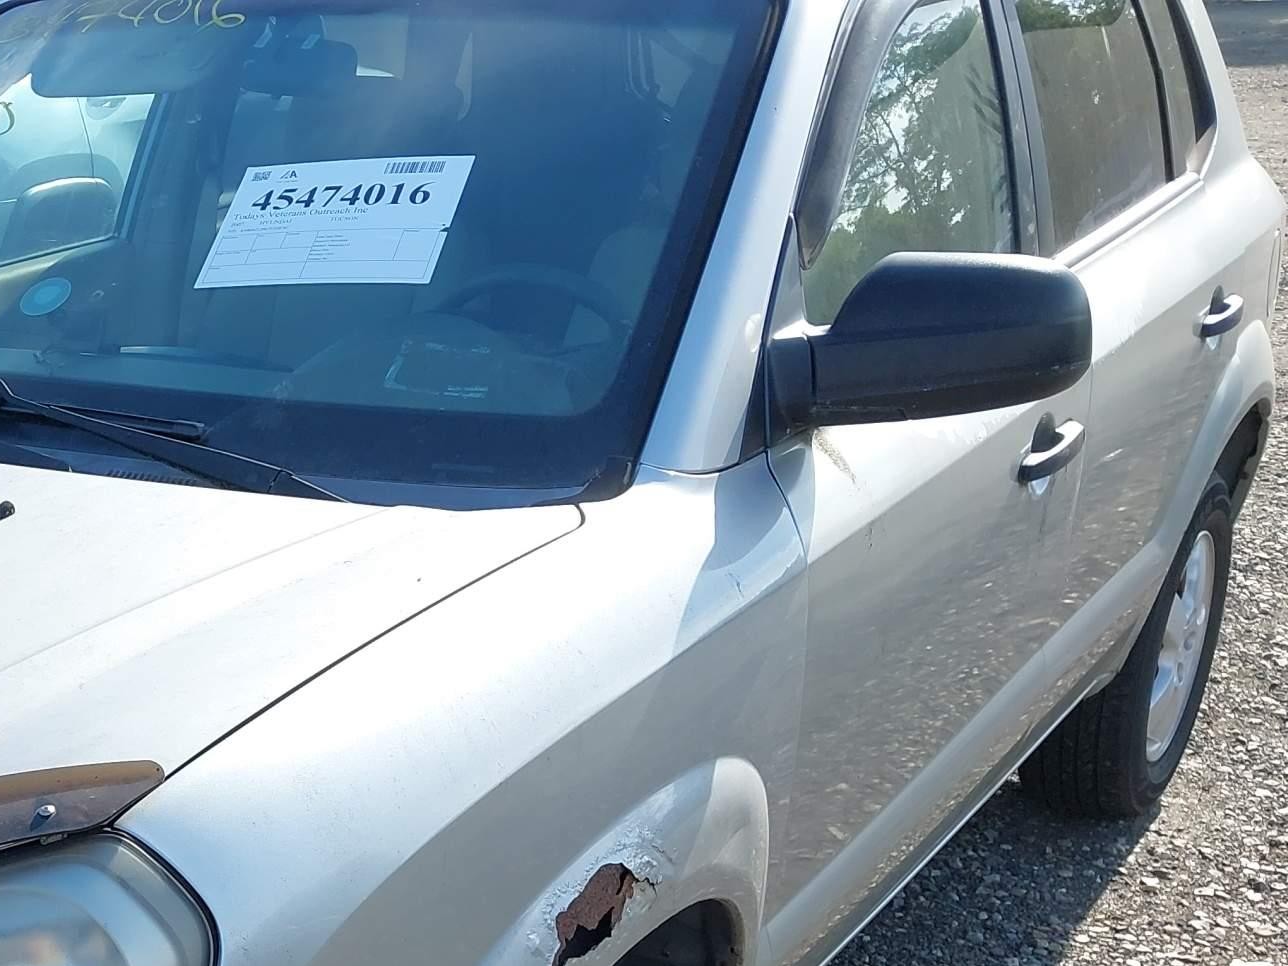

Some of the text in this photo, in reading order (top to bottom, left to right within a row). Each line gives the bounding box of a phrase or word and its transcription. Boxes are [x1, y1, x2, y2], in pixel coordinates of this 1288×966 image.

[251, 181, 437, 211] 45474016
[234, 206, 369, 221] Todays Veterans Outreach Inc
